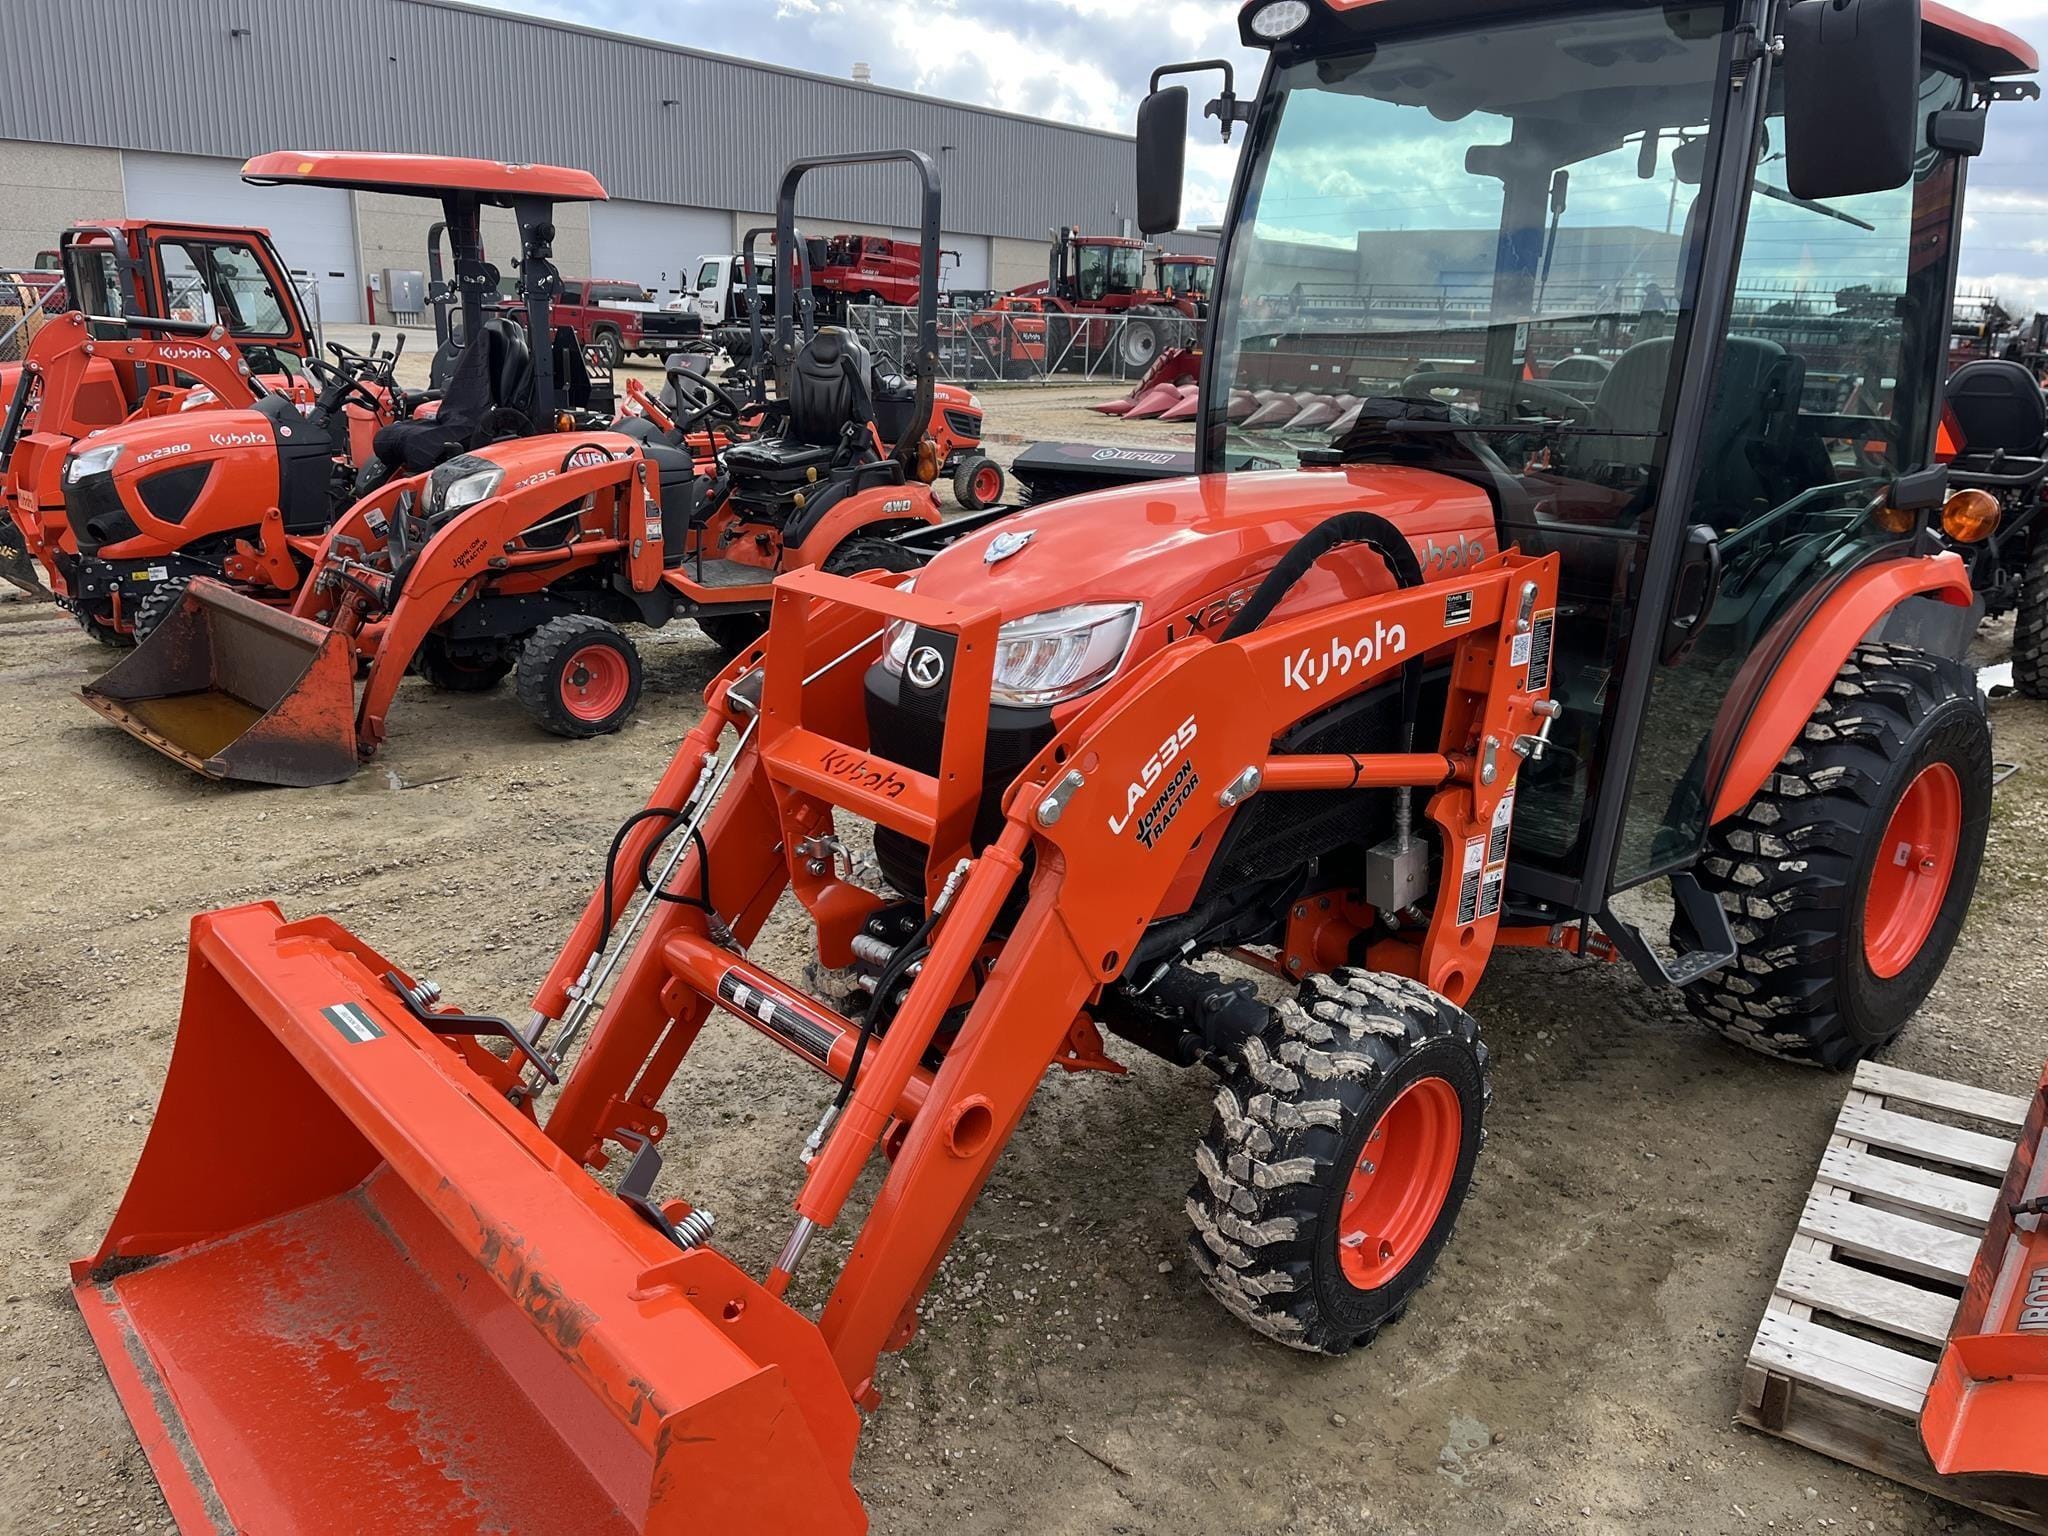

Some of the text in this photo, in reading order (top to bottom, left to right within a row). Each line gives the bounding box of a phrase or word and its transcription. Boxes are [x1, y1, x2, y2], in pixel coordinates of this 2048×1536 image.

[661, 272, 666, 281] 2
[159, 346, 211, 360] Kubota
[137, 443, 192, 463] BX2380
[209, 431, 267, 446] Kubota
[882, 500, 912, 513] 4WD
[1418, 534, 1485, 575] ubota
[1166, 583, 1263, 646] LX26
[1284, 620, 1406, 691] Kubota
[820, 749, 906, 798] Kubota
[1108, 713, 1198, 835] LA535
[1136, 759, 1193, 841] JOHNSON
[1141, 773, 1199, 850] TRACTOR
[2018, 1267, 2048, 1330] BOT
